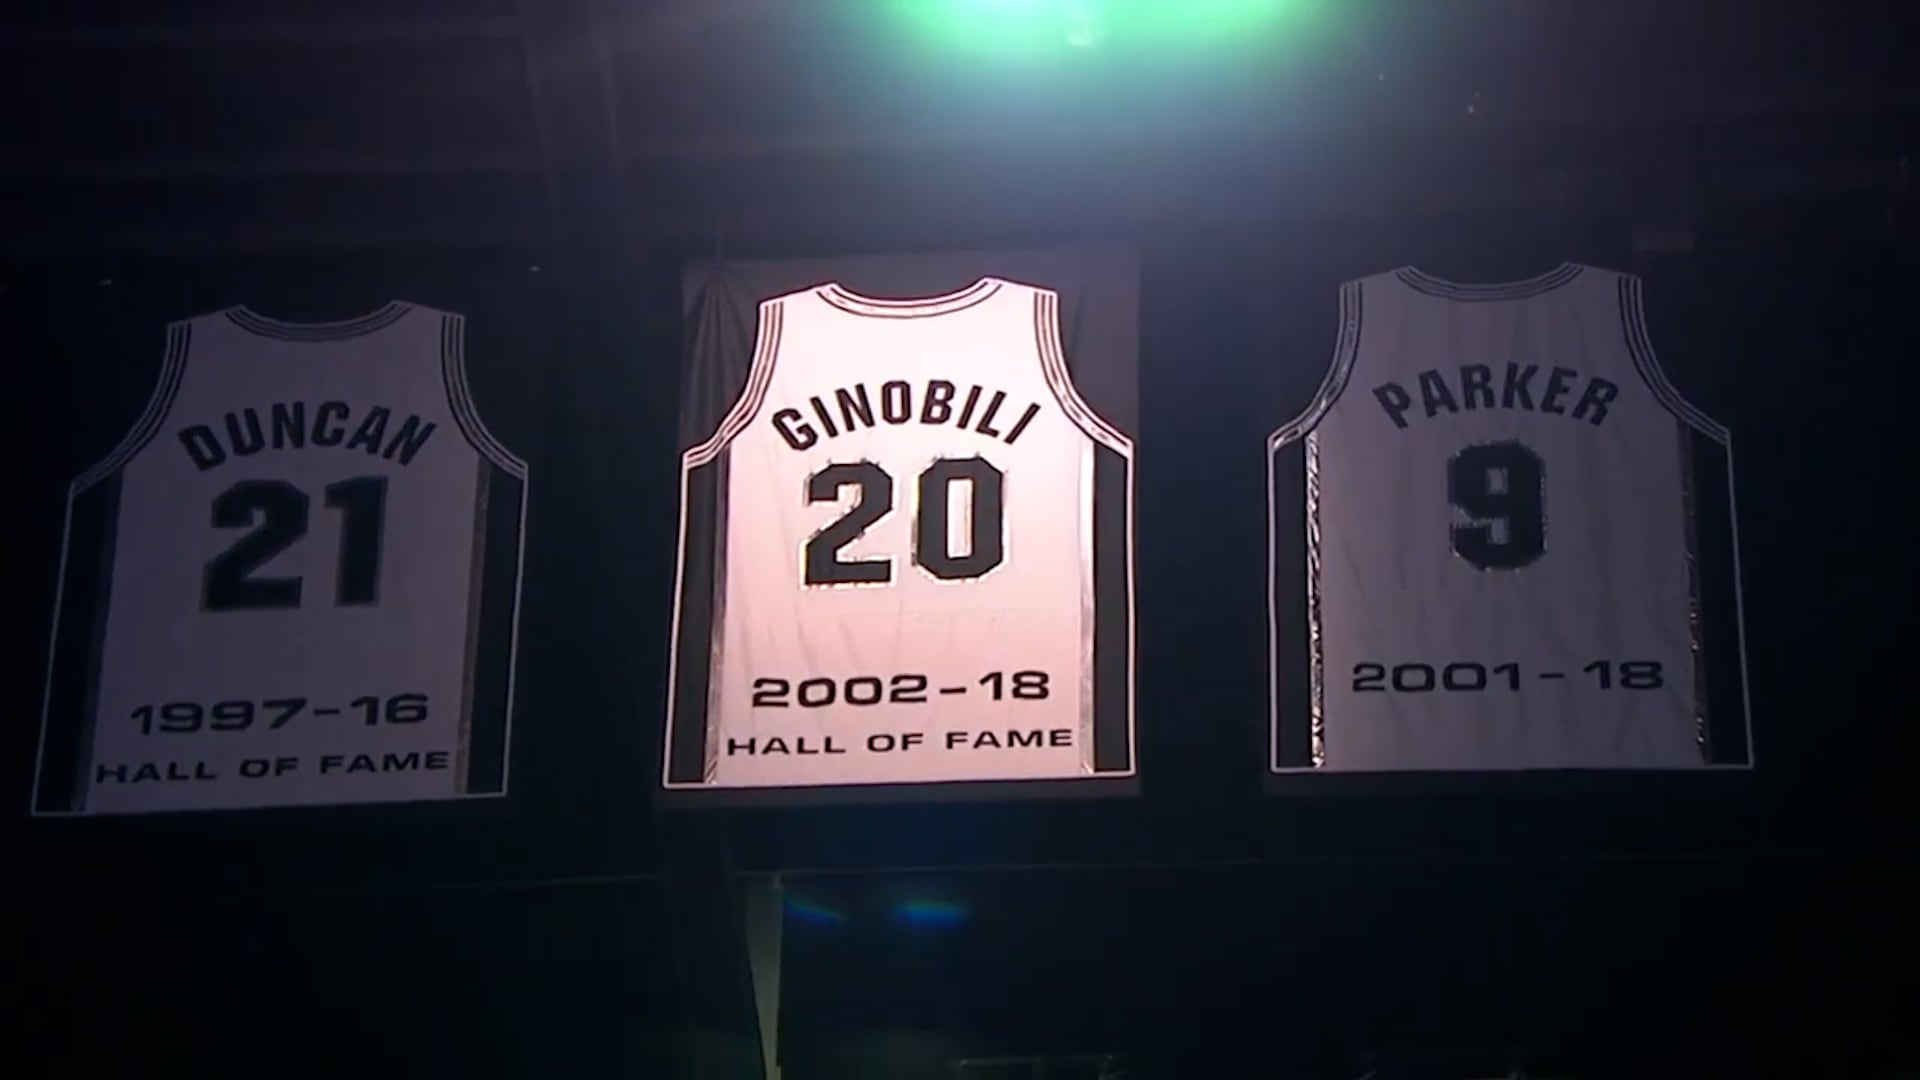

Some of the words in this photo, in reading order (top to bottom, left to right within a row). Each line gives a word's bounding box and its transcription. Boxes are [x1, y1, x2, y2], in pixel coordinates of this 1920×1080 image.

[772, 380, 1040, 450] GINOBILI
[1372, 362, 1619, 429] PARKER
[178, 401, 437, 471] DUNCAN
[805, 457, 1004, 585] 20
[1448, 440, 1547, 571] 9
[201, 475, 388, 611] 21
[96, 762, 217, 783] HALL
[240, 757, 298, 777] OF
[320, 752, 449, 773] FAME
[728, 736, 845, 755] HALL
[868, 733, 923, 751] OF
[947, 729, 1072, 750] FAME
